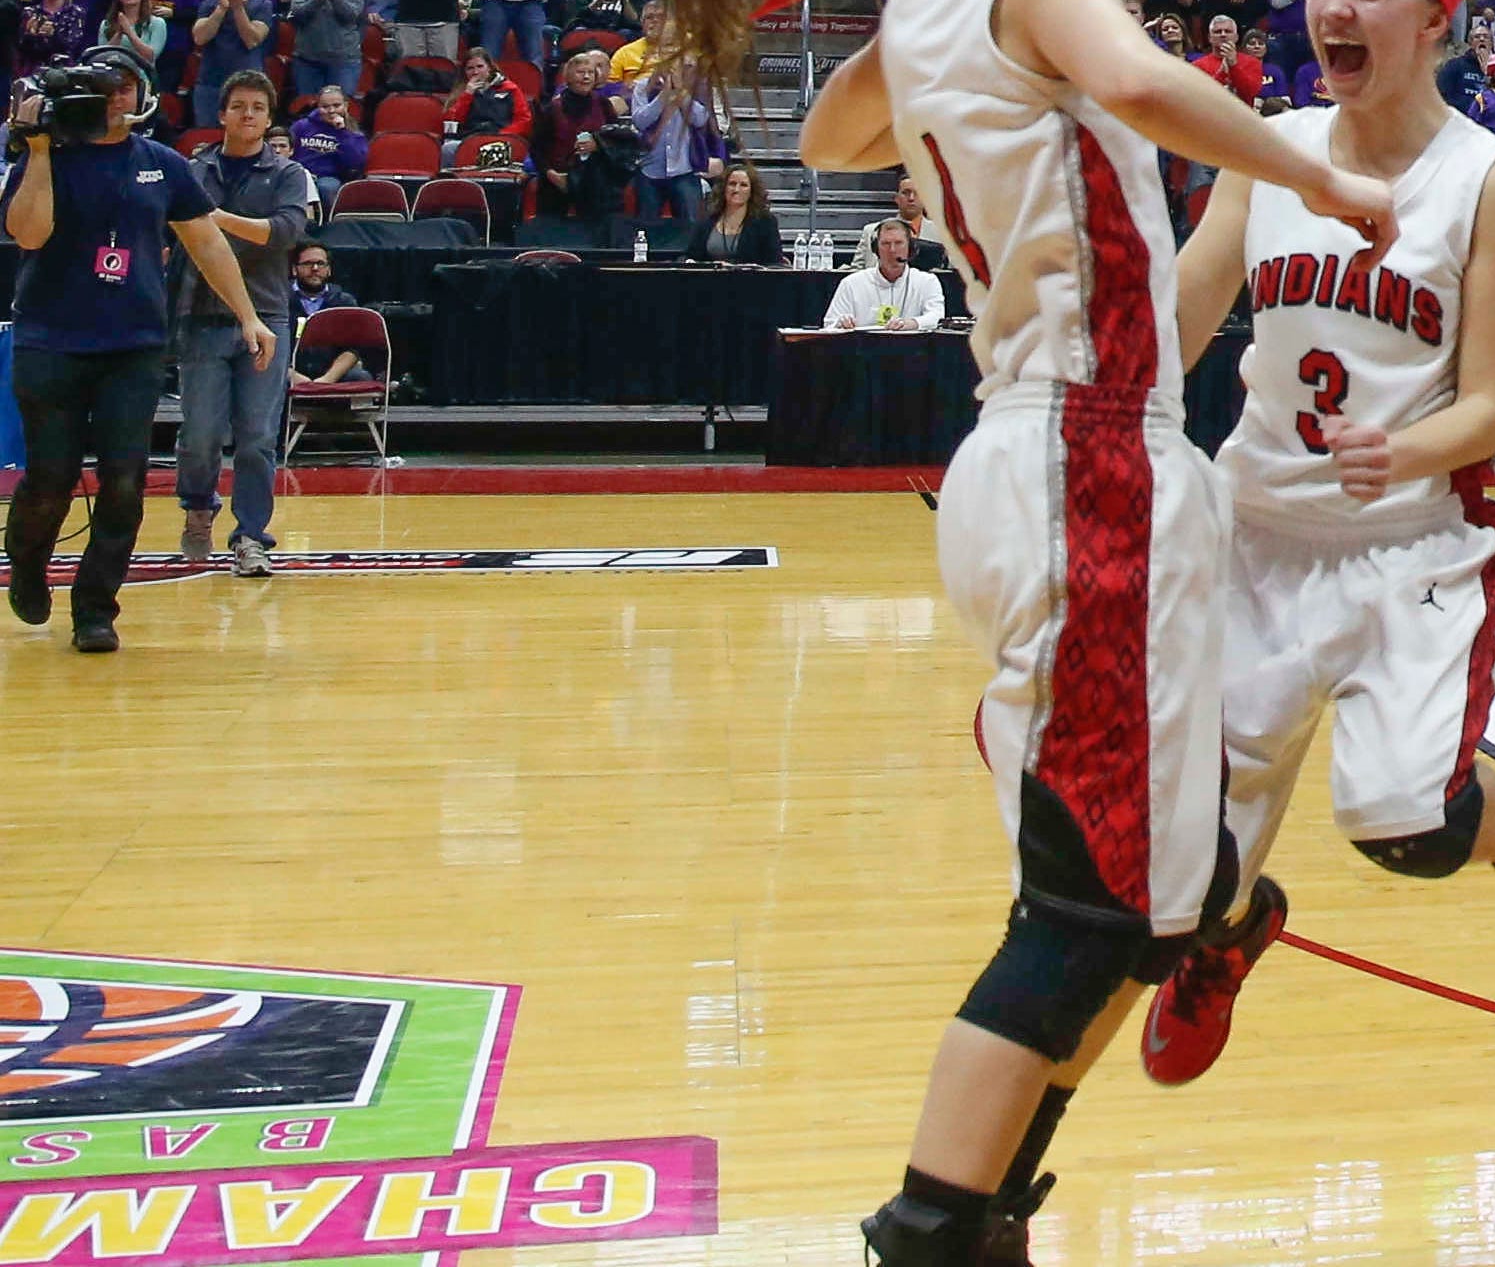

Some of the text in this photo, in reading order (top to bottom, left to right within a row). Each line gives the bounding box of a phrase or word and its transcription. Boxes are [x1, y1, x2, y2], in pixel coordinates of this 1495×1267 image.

[759, 57, 802, 67] GRINNEL
[1296, 348, 1349, 455] 3
[10, 1115, 338, 1169] BAS
[0, 1159, 657, 1264] CHAM
